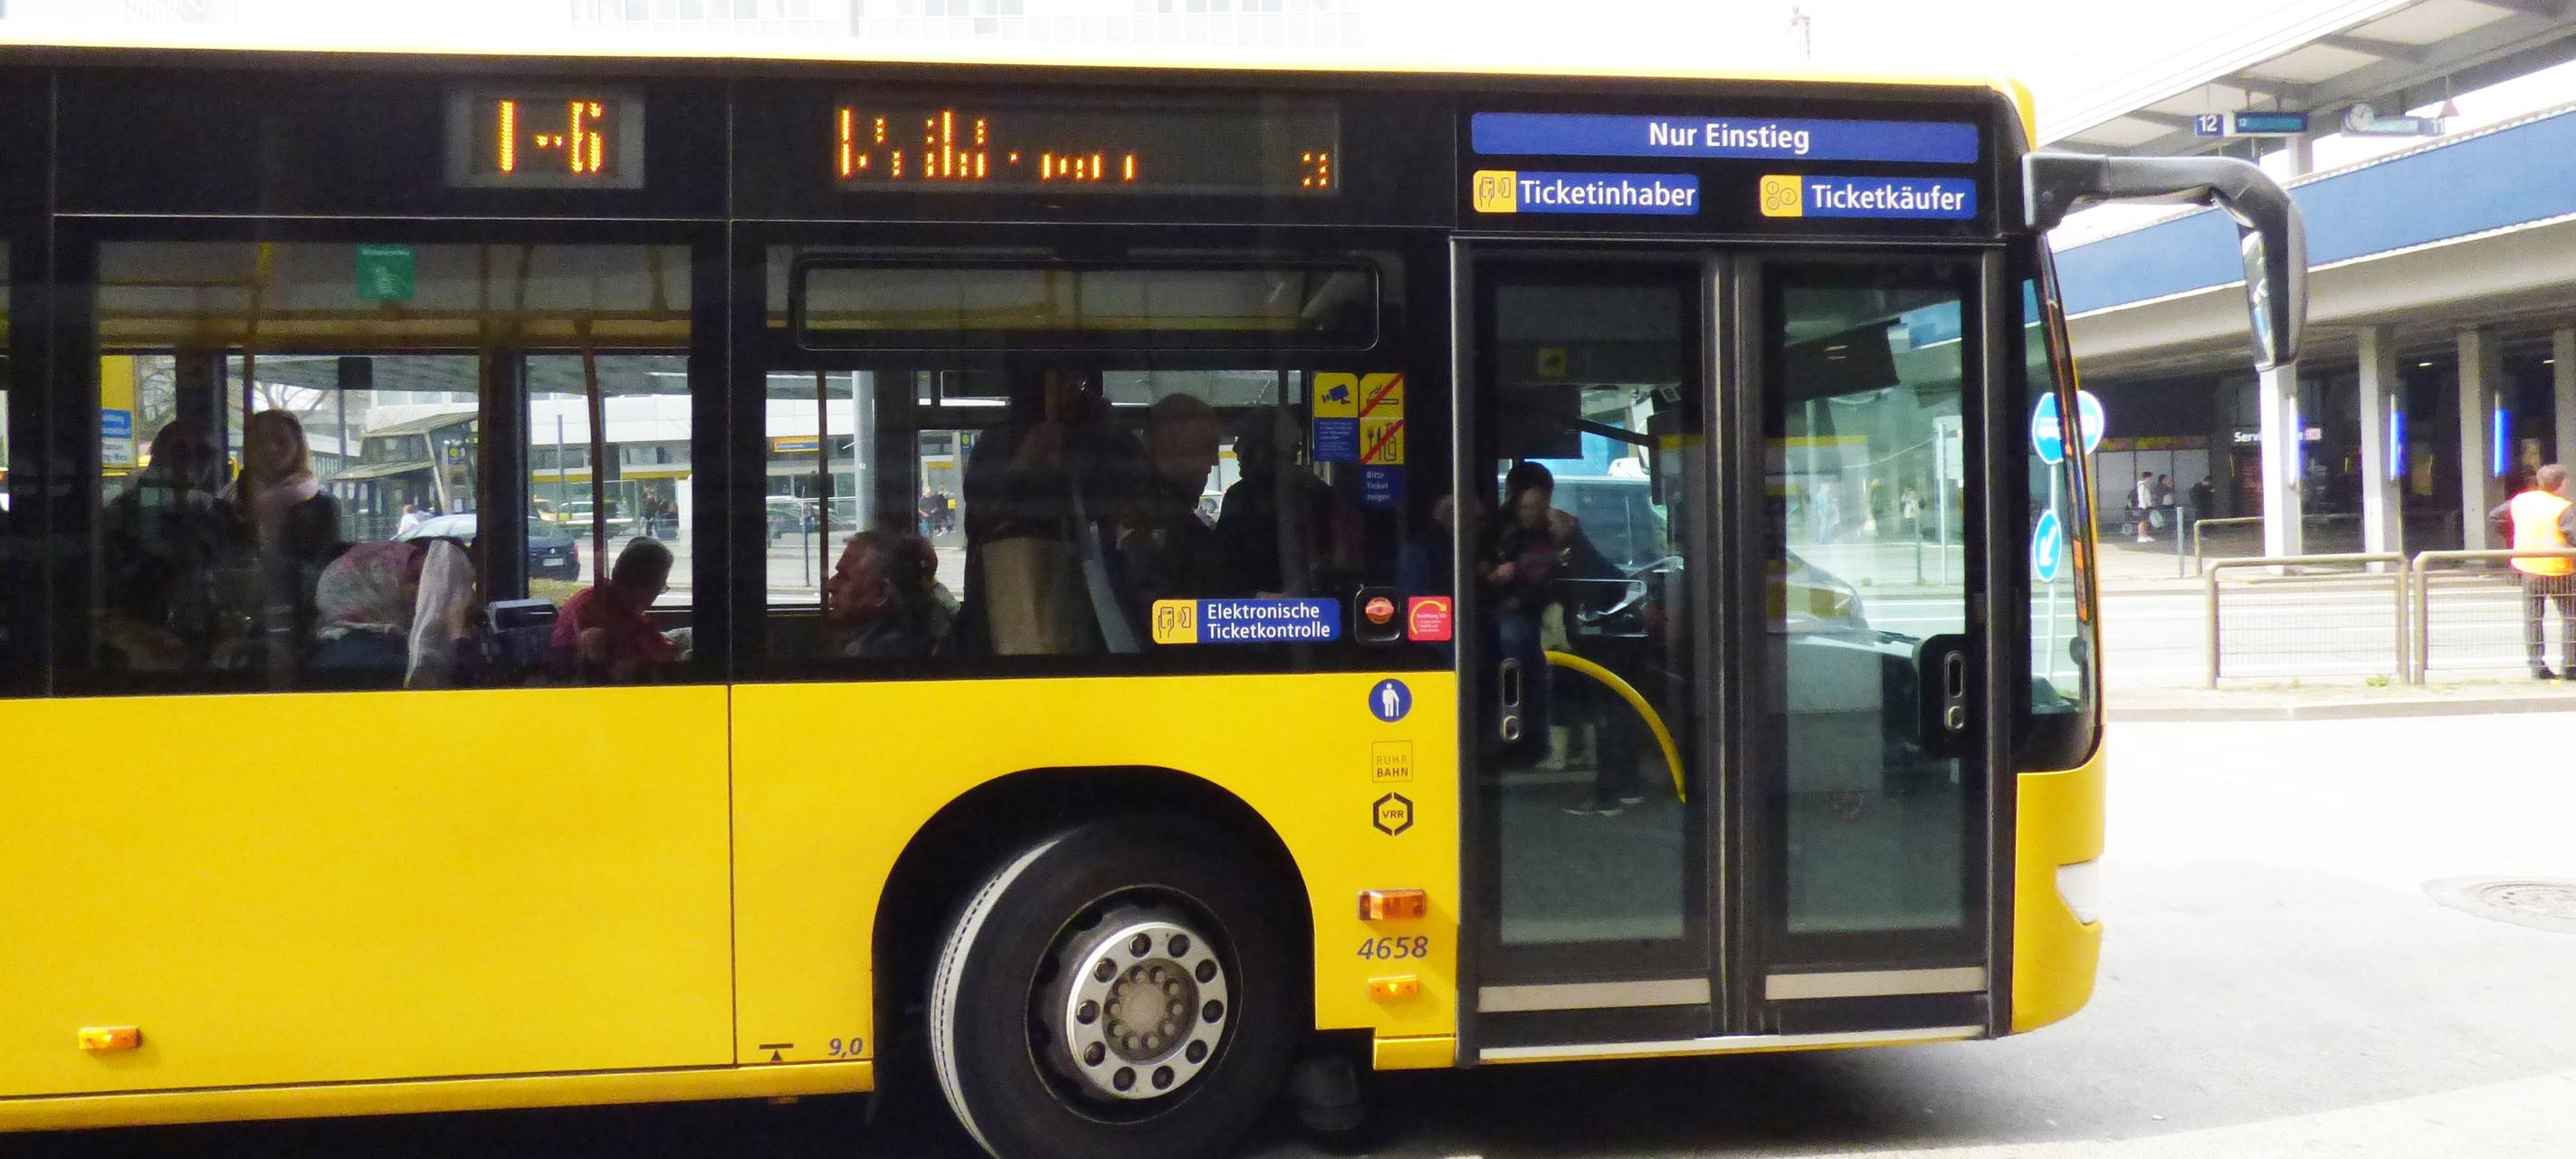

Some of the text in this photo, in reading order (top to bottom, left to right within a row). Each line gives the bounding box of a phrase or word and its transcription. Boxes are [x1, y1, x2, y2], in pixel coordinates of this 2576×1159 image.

[2199, 115, 2218, 132] 12
[1649, 122, 1809, 155] Nur Einstieg
[1520, 178, 1696, 207] Ticketinhaber
[1811, 183, 1965, 211] Ticketkäufer
[1366, 470, 1385, 479] Bitte
[1207, 601, 1320, 619] Elektronische
[1207, 621, 1331, 639] Ticketkontrolle
[1376, 754, 1408, 765] RUHR
[1377, 767, 1408, 778] BAHN
[1381, 809, 1404, 819] VRR
[1357, 935, 1428, 960] 4658
[828, 1037, 863, 1058] 9,0
